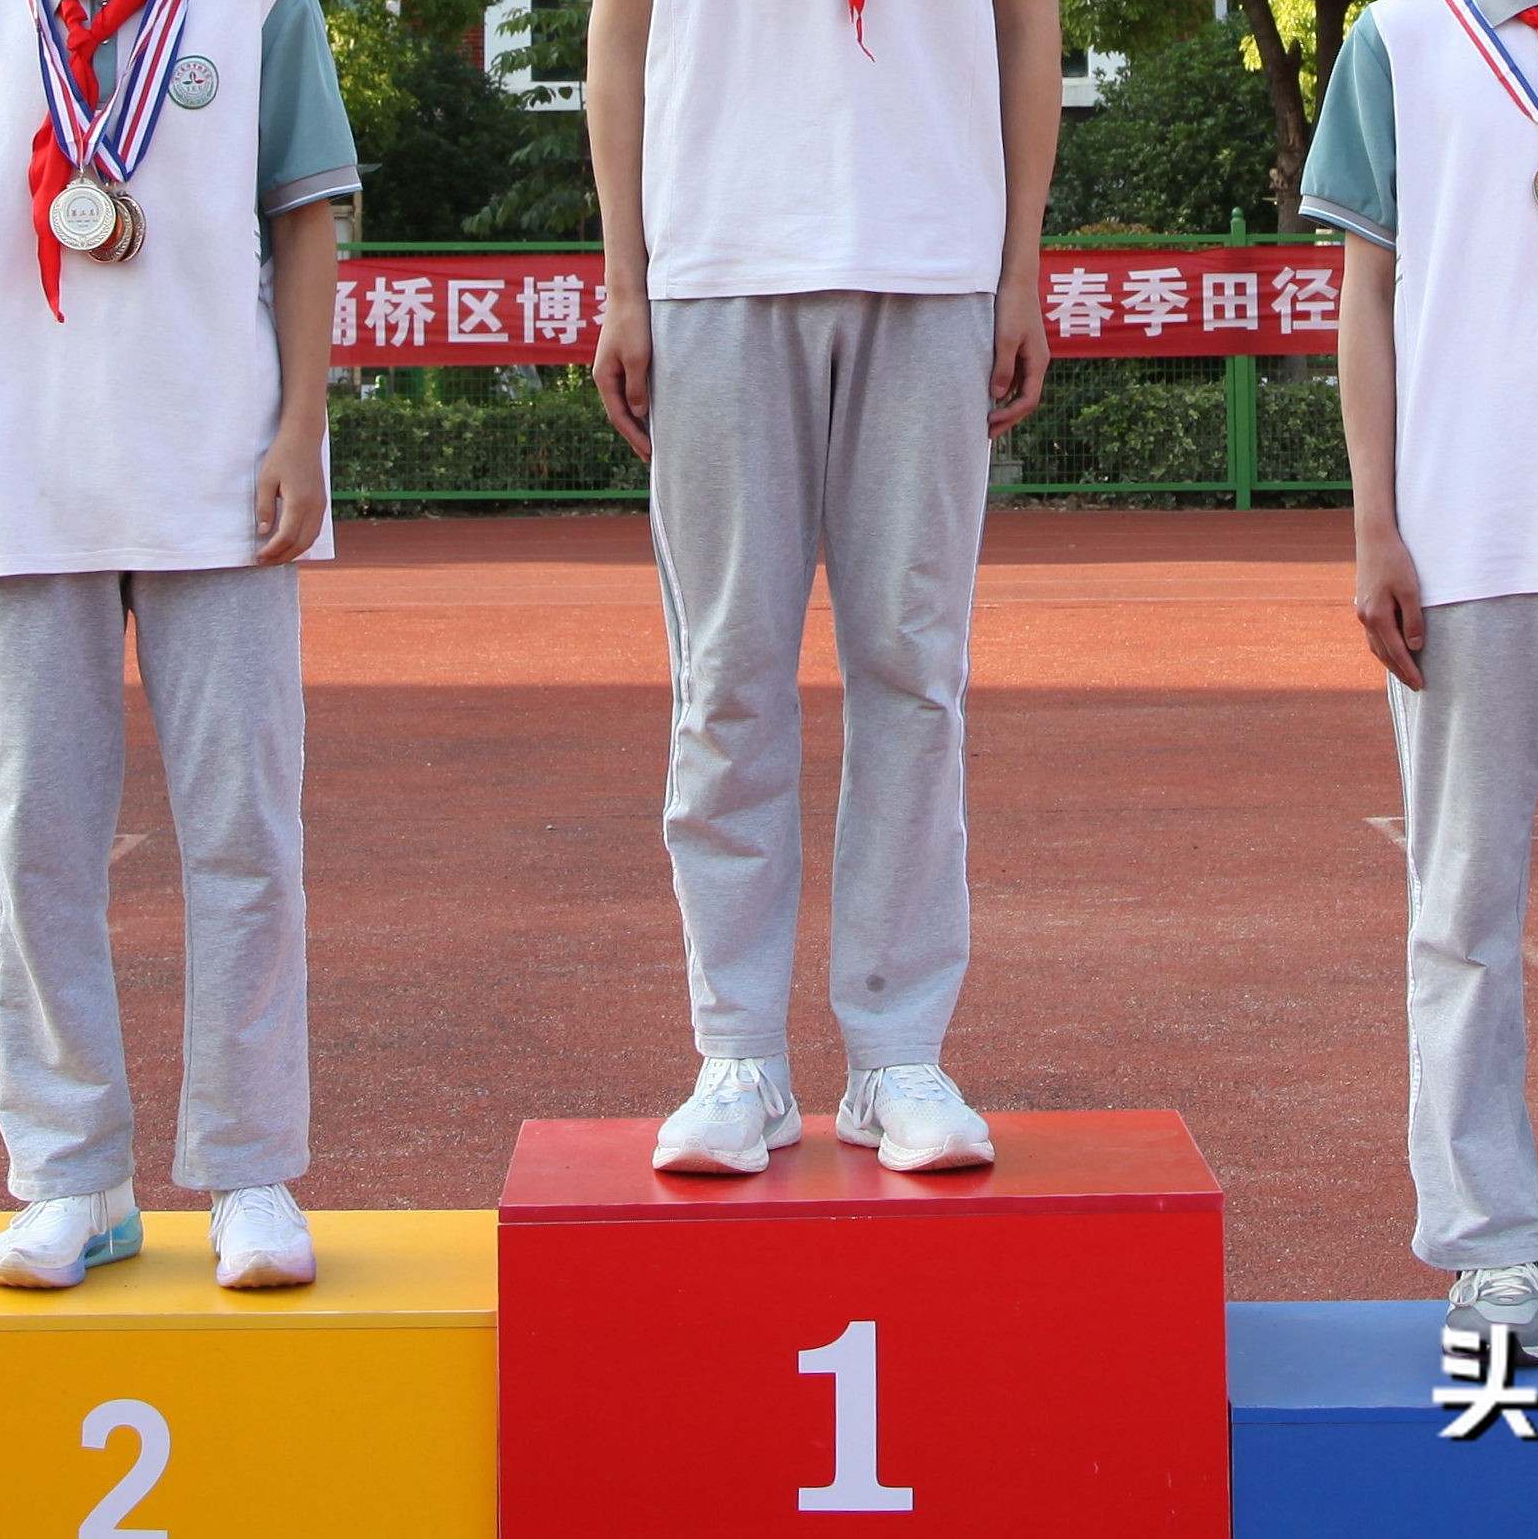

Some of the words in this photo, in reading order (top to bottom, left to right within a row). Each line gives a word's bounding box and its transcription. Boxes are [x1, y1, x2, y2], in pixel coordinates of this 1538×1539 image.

[332, 275, 608, 347] 桥区博
[1045, 266, 1340, 337] 春季田径
[77, 1398, 172, 1539] 2
[797, 1320, 914, 1512] 1
